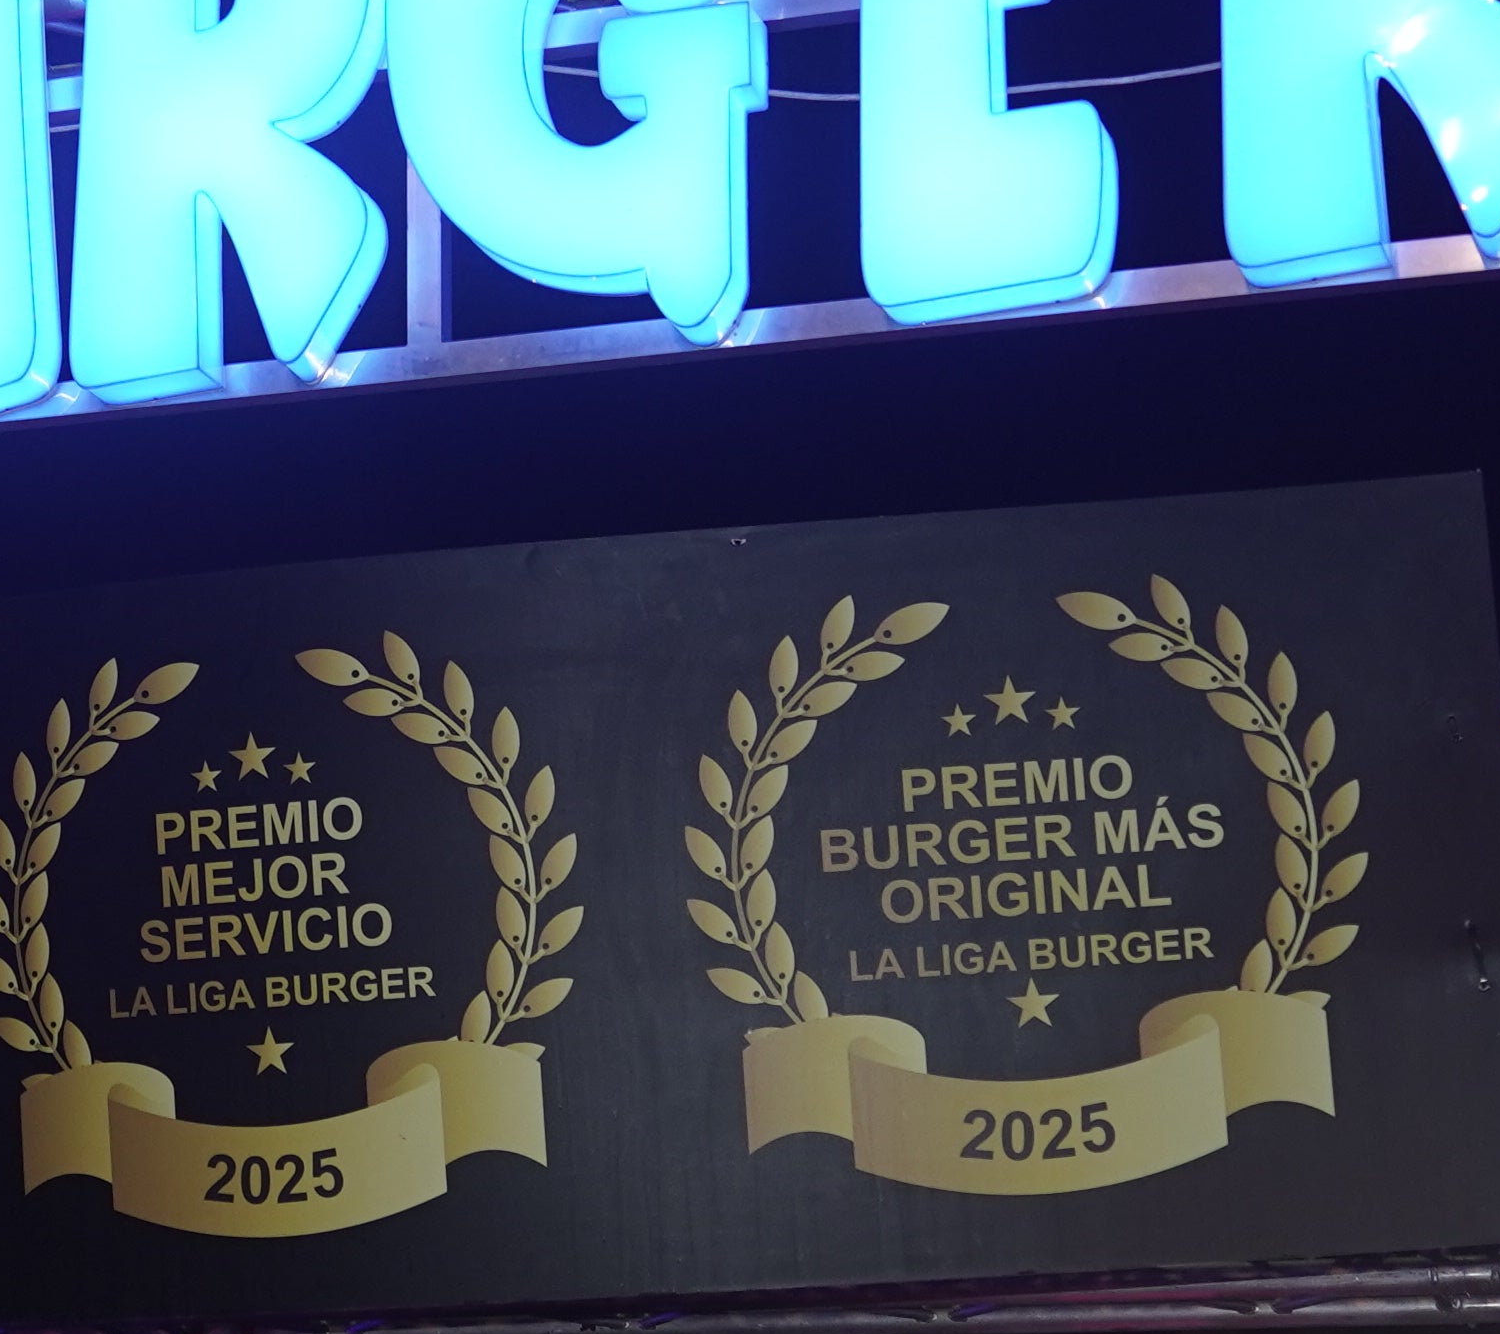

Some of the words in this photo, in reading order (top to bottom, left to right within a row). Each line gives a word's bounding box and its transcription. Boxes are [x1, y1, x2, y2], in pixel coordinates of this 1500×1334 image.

[901, 754, 1133, 813] PREMIO
[155, 796, 363, 855] PREMIO
[821, 814, 1076, 873] BURGER
[1093, 797, 1225, 855] MÁS
[160, 852, 349, 908] MEJOR
[880, 863, 1172, 925] ORIGINAL
[140, 902, 392, 964] SERVICIO
[849, 947, 906, 982] LA
[917, 940, 1016, 975] LIGA
[1029, 927, 1215, 971] BURGER
[109, 986, 158, 1019] LA
[166, 978, 255, 1013] LIGA
[266, 965, 436, 1008] BURGER
[959, 1101, 1116, 1162] 2025
[203, 1147, 344, 1205] 2025
